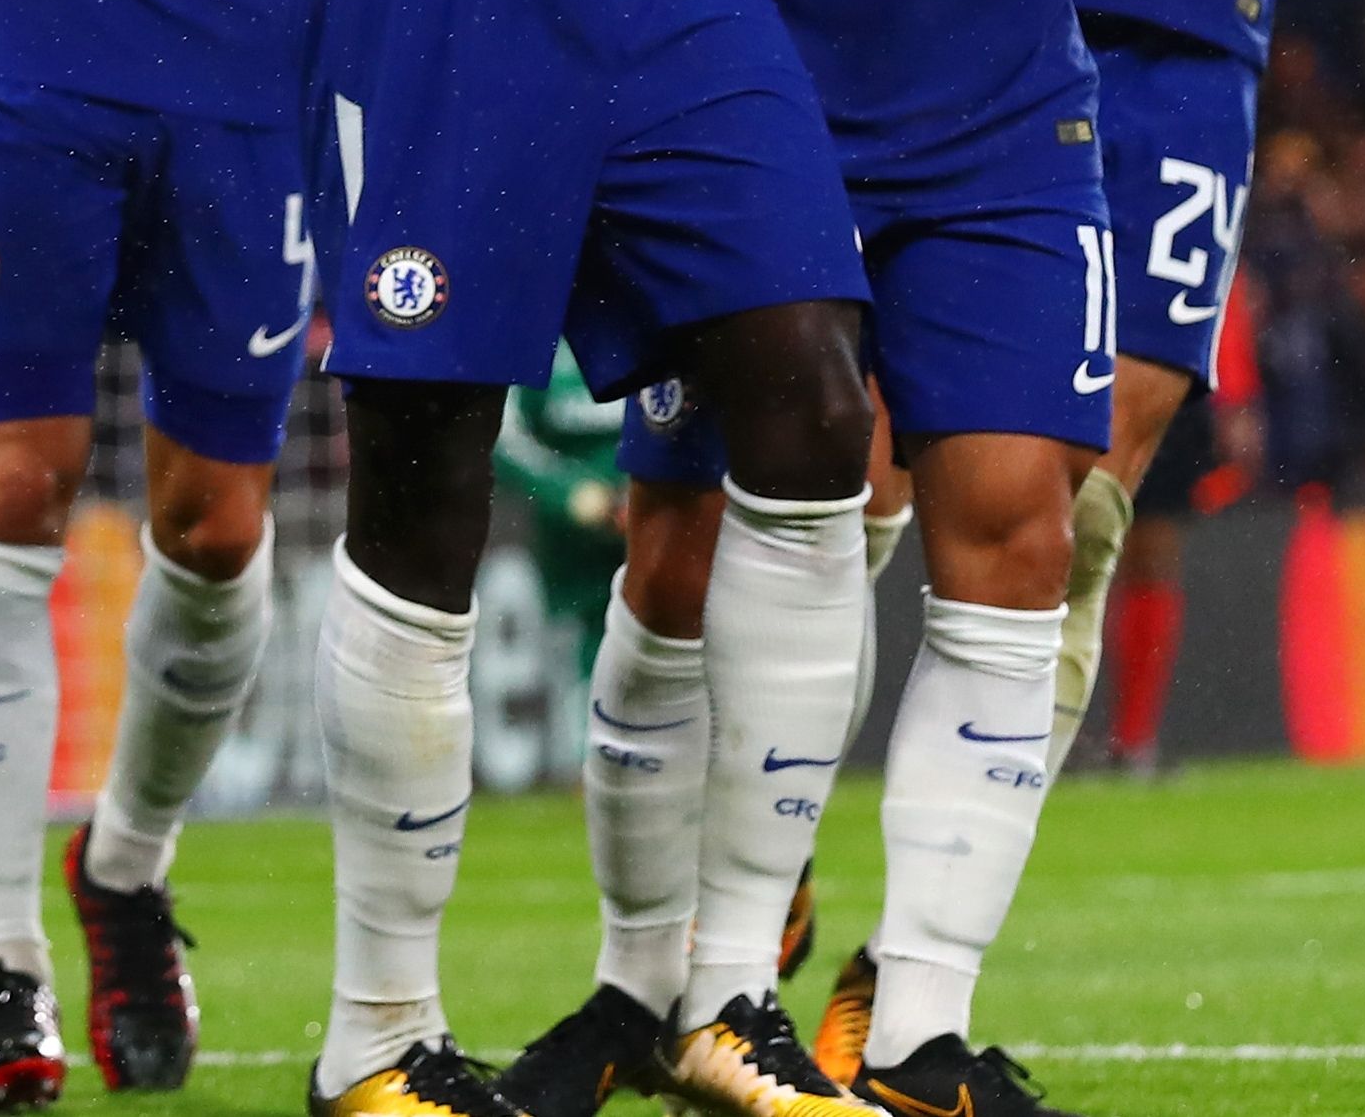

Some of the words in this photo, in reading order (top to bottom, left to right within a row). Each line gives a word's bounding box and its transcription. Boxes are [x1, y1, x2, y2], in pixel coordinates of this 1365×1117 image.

[1147, 157, 1246, 306] 24
[597, 745, 664, 773] CFC
[985, 766, 1043, 788] CFC
[775, 798, 818, 822] CFC
